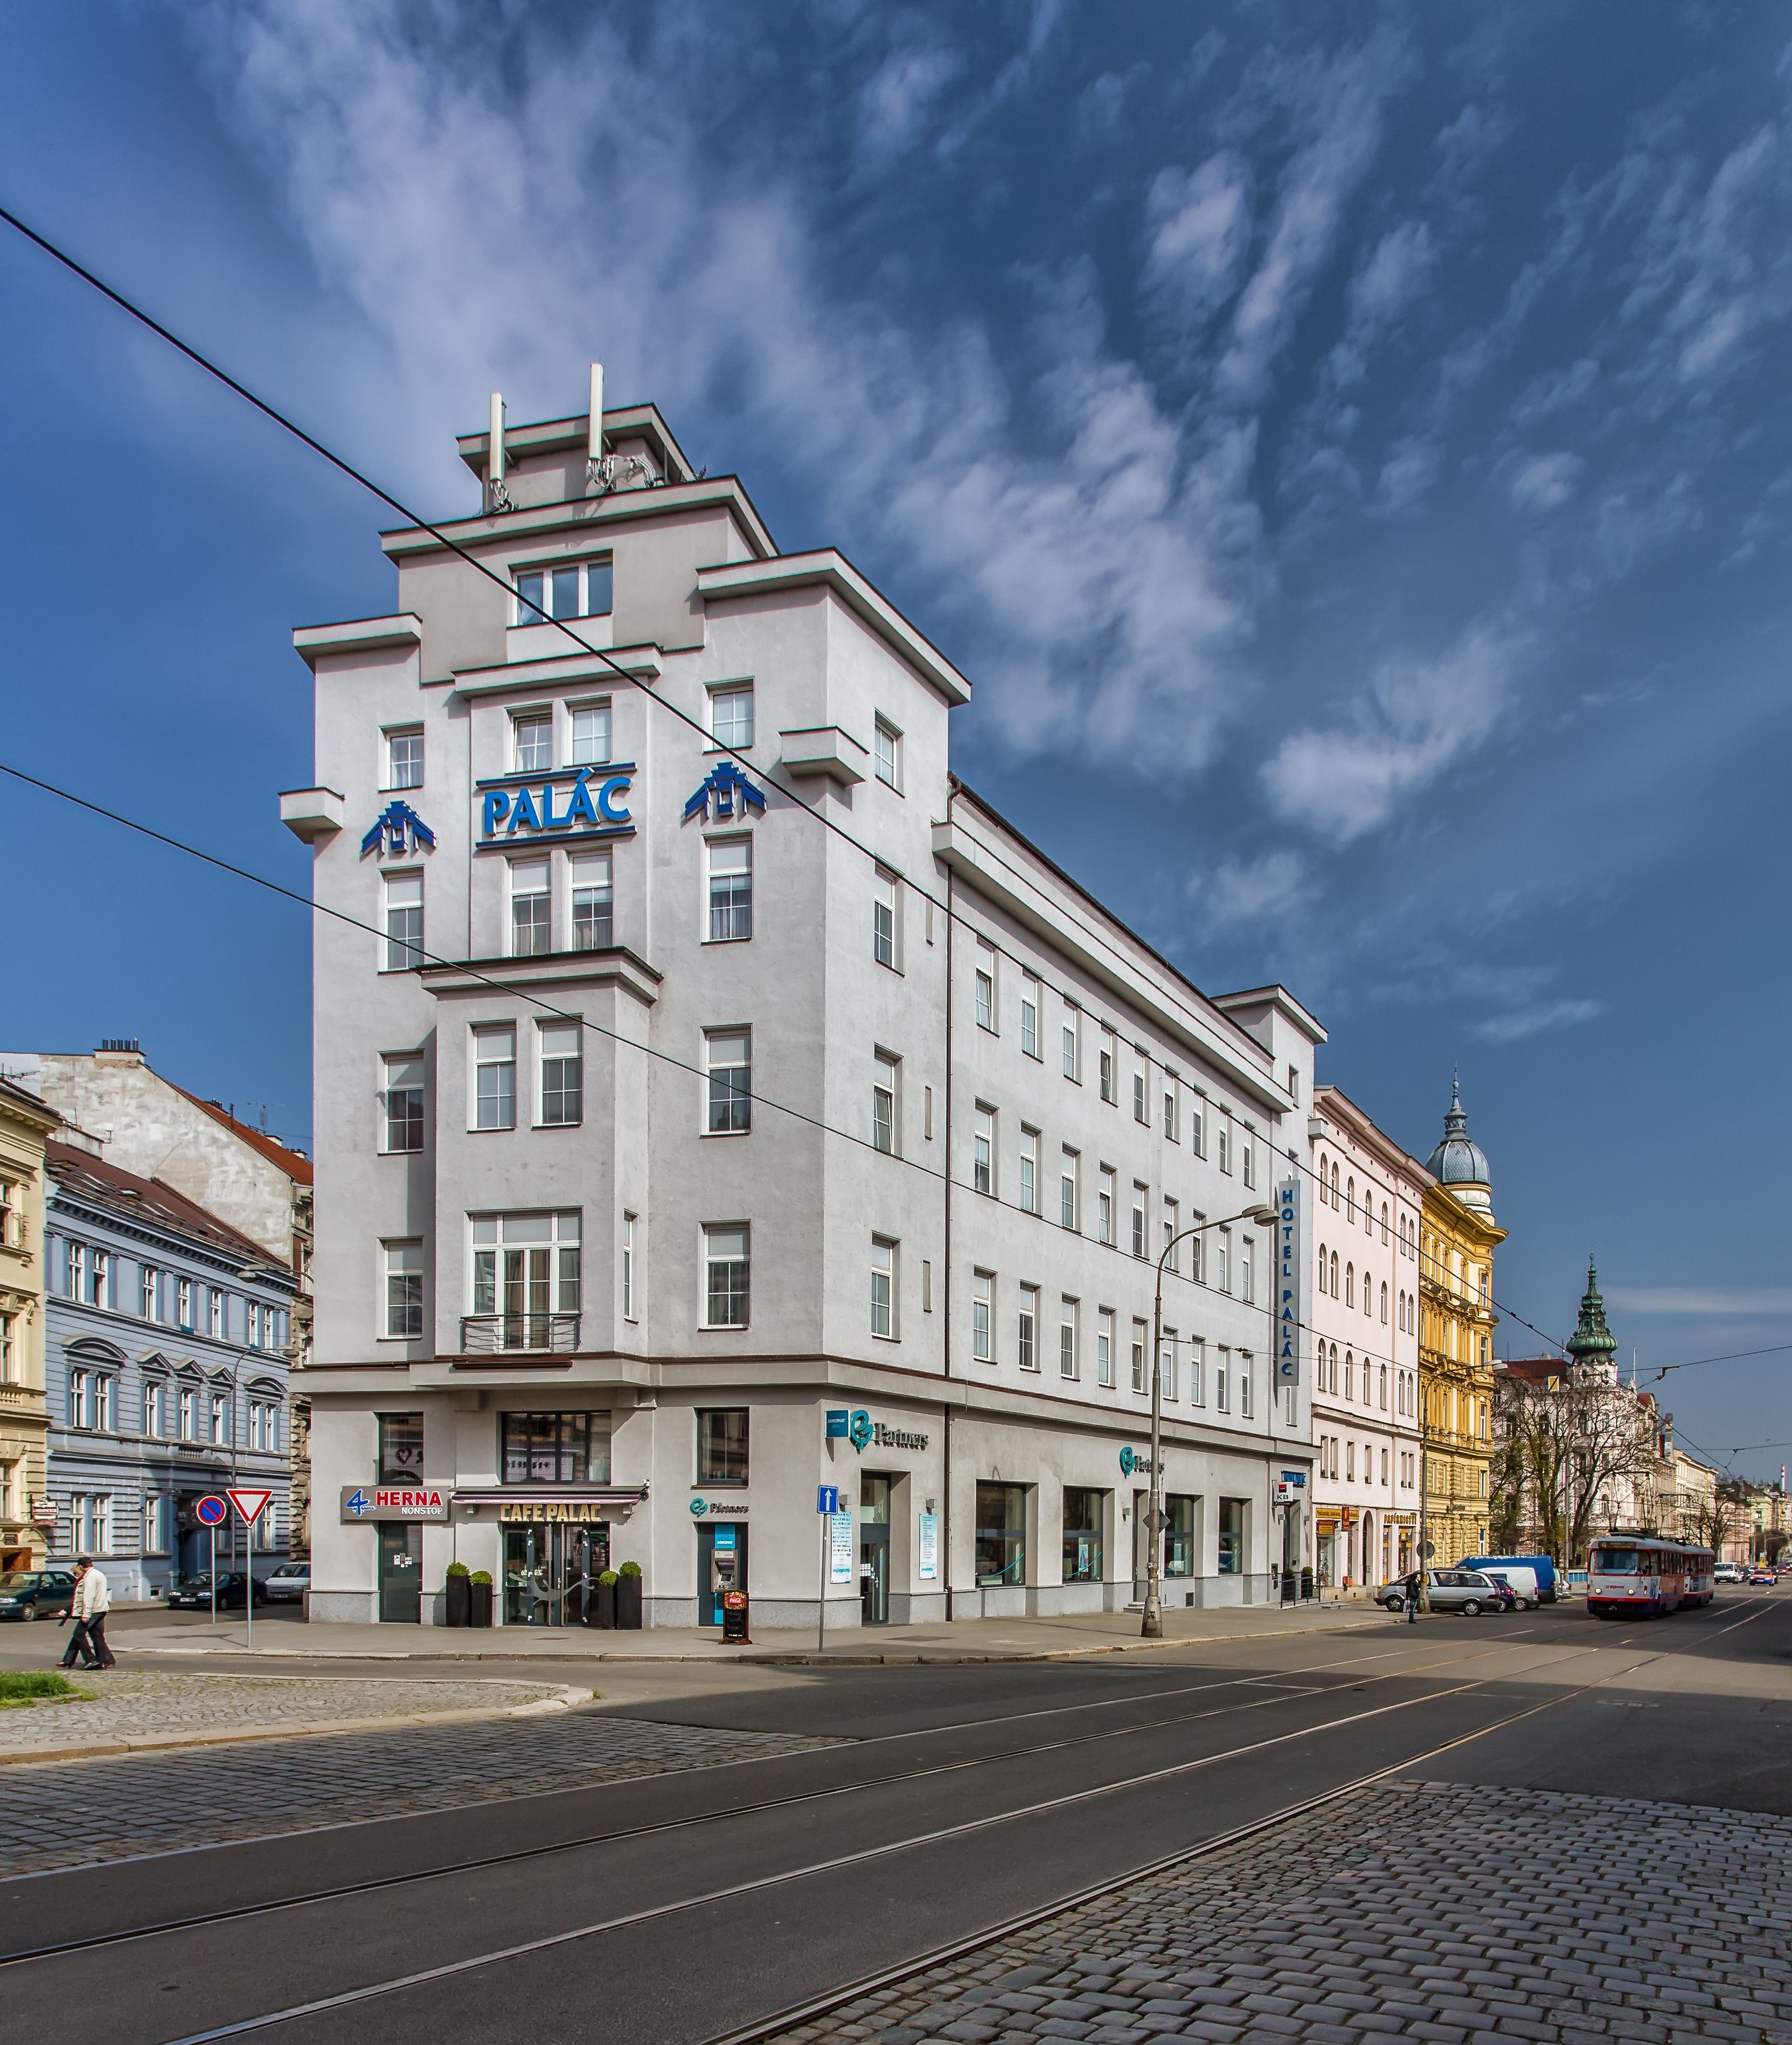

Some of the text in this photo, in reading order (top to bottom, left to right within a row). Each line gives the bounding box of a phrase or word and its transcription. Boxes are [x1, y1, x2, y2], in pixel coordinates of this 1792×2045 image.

[484, 766, 632, 836] PALÁC
[1281, 1189, 1294, 1376] HOTEL PALÁC
[874, 1422, 930, 1448] Partners
[346, 1488, 371, 1517] 4
[376, 1491, 443, 1506] HERNA
[401, 1507, 443, 1515] NONSTOP
[709, 1502, 749, 1513] Partners
